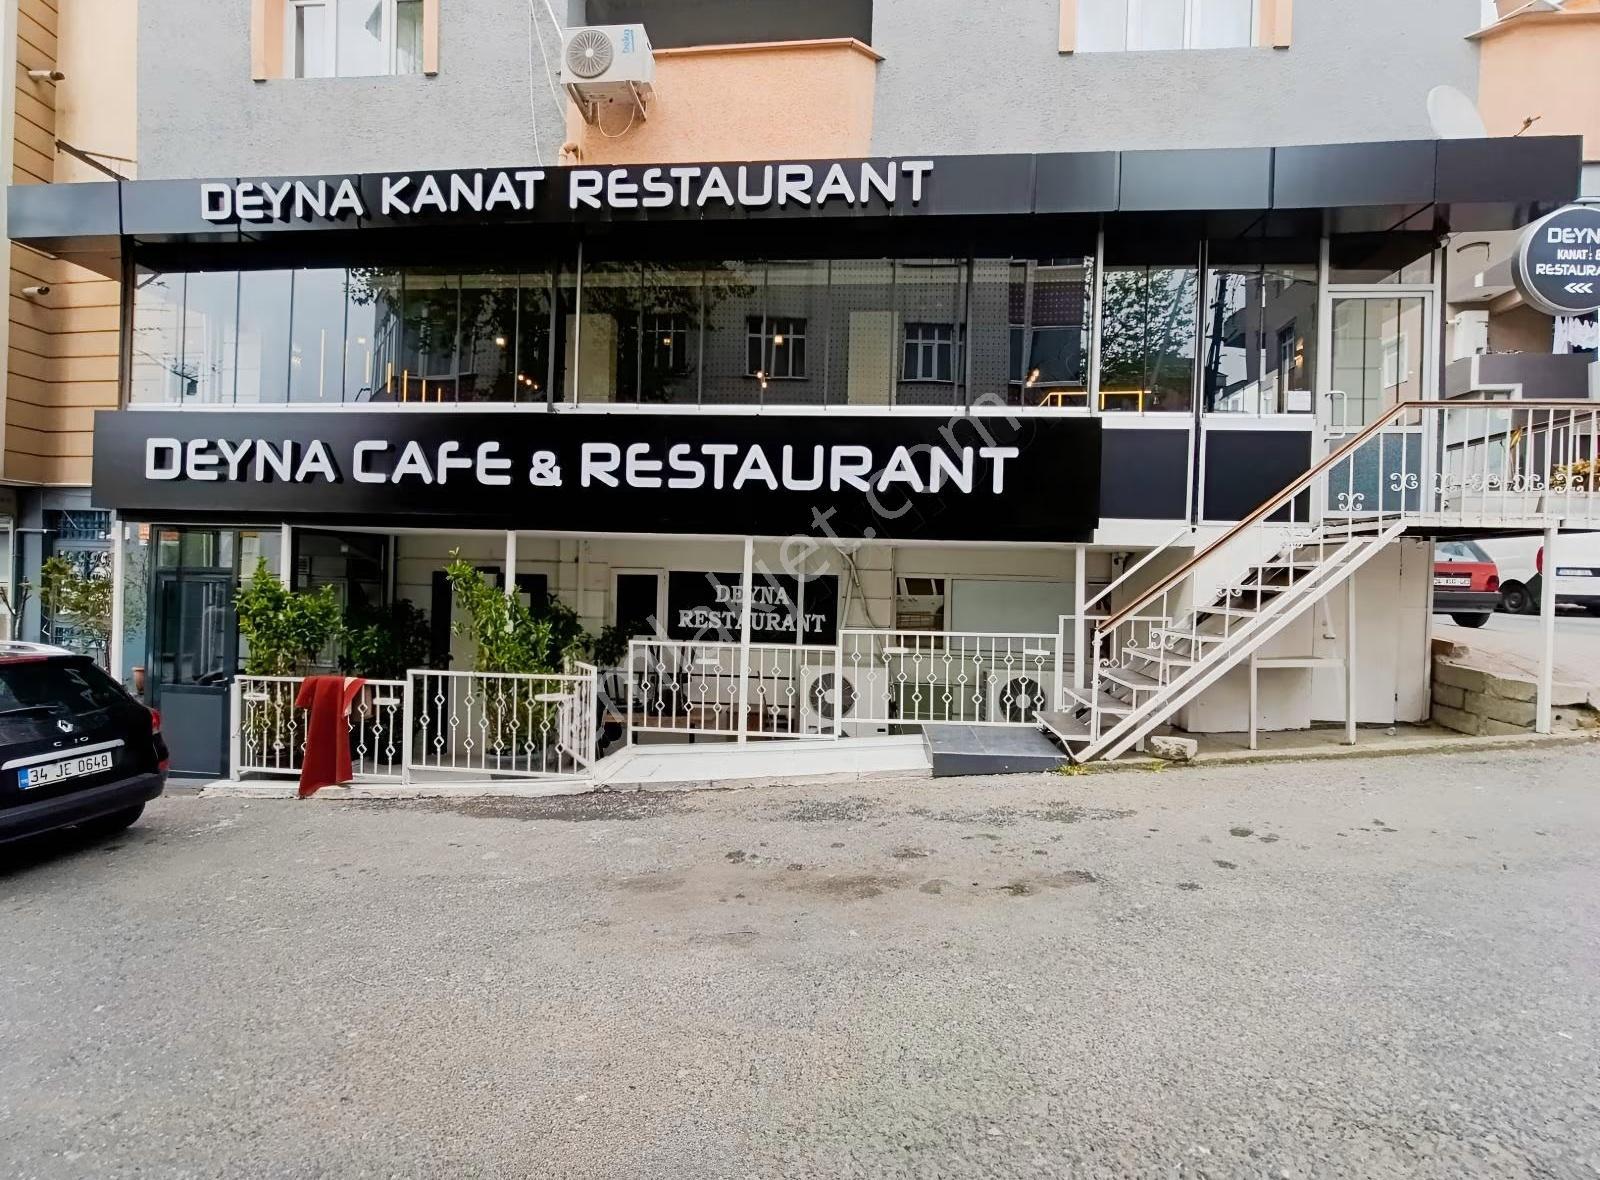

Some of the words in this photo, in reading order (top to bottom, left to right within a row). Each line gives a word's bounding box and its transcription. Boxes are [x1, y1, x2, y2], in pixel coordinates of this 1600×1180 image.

[200, 179, 363, 220] DEYNA
[382, 171, 545, 215] KANAT
[569, 160, 934, 209] RESTAURANT
[145, 438, 336, 483] DEYNA
[353, 440, 512, 486] CAFE
[529, 451, 562, 487] &
[581, 443, 1020, 494] RESTAURANT
[30, 767, 48, 783] 34
[56, 762, 73, 778] JE
[78, 754, 109, 773] 0648
